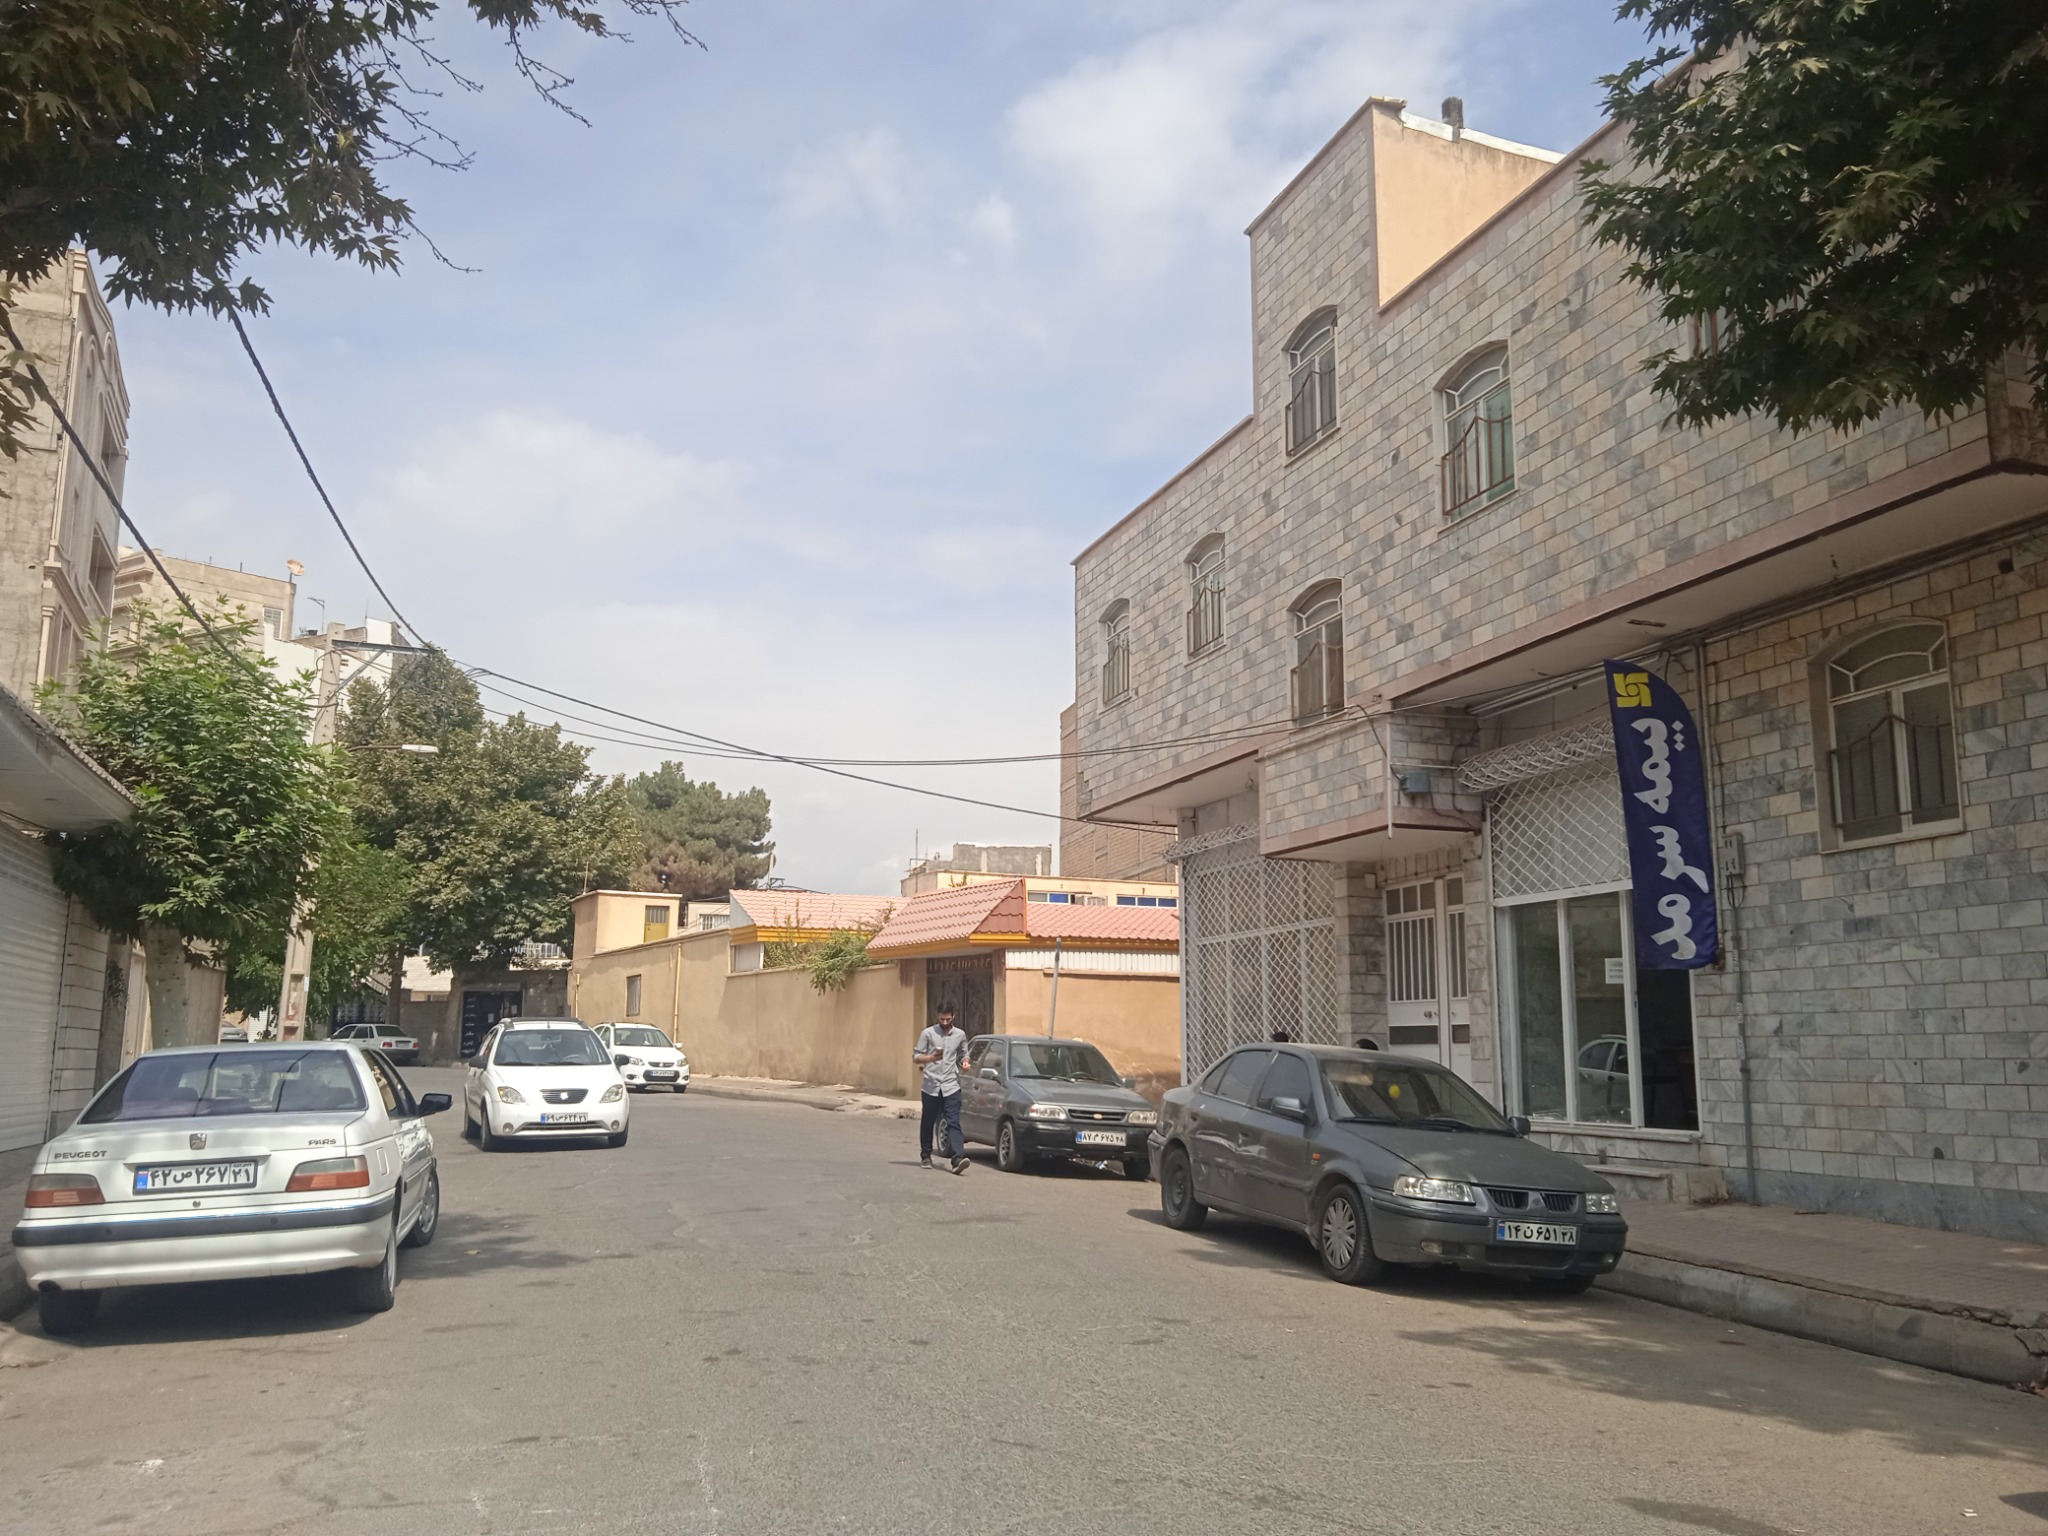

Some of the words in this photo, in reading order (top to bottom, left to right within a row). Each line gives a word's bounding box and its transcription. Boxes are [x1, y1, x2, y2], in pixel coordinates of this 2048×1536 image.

[1630, 718, 1685, 814] بیمه
[308, 1138, 337, 1146] PARS
[54, 1150, 107, 1159] PEUGEOT
